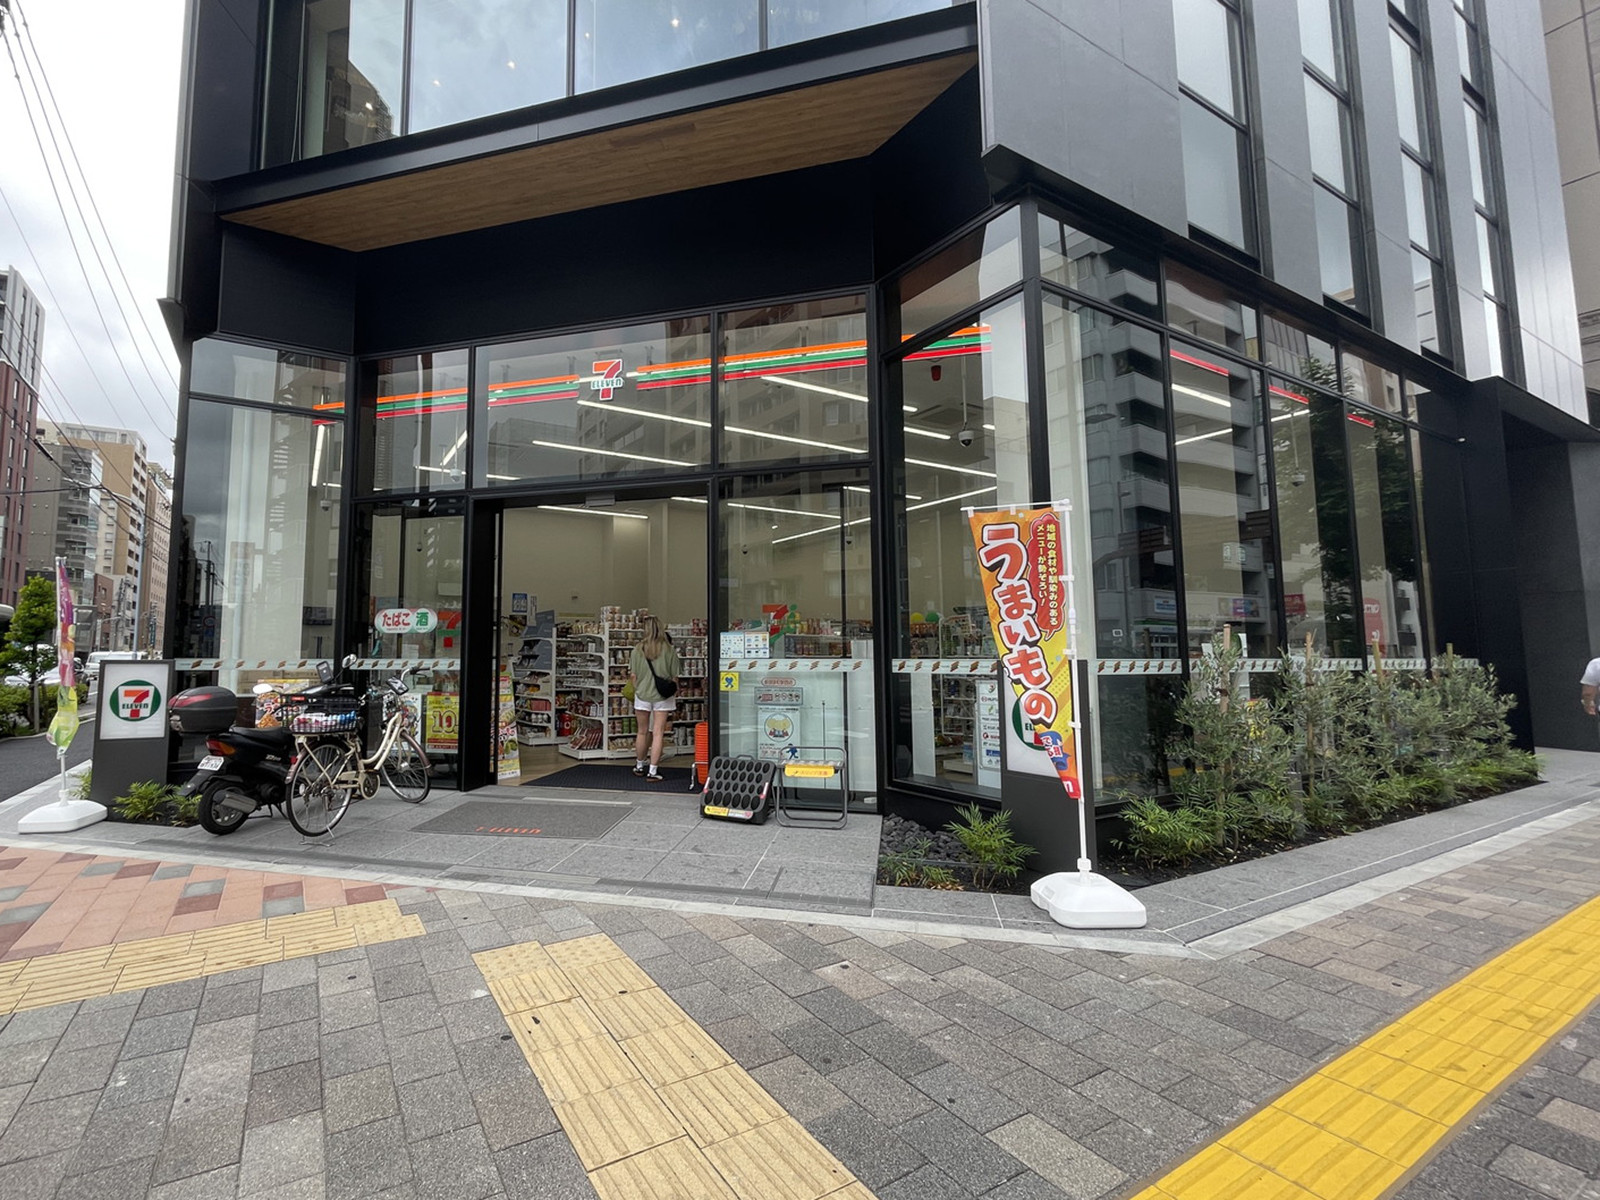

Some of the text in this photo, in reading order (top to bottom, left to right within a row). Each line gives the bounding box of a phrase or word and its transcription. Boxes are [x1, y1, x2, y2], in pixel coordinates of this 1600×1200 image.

[593, 359, 622, 400] 7
[382, 611, 429, 627] たばこ 酒
[979, 524, 1058, 725] うまいもの
[123, 689, 150, 718] 7
